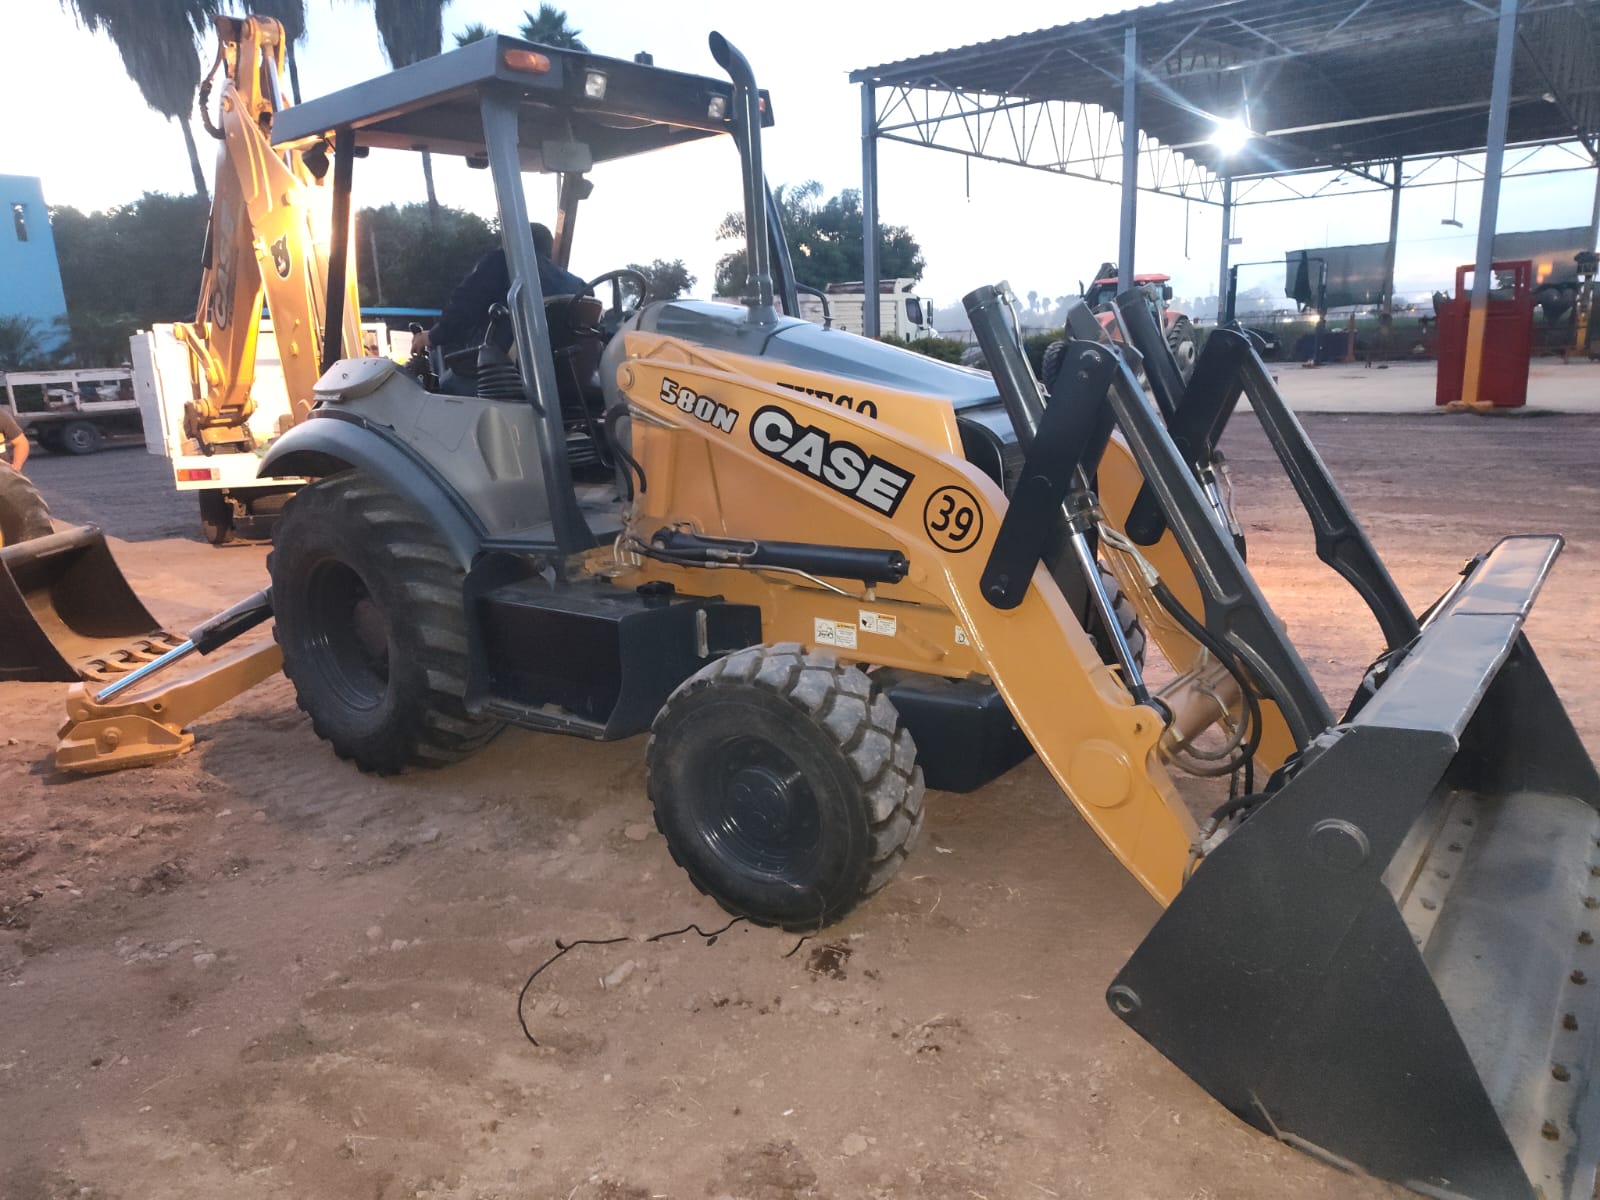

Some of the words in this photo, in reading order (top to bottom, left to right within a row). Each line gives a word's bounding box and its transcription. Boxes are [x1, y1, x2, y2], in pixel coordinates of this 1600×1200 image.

[660, 377, 740, 434] 580N
[751, 408, 911, 515] CASE
[930, 494, 975, 542] 39
